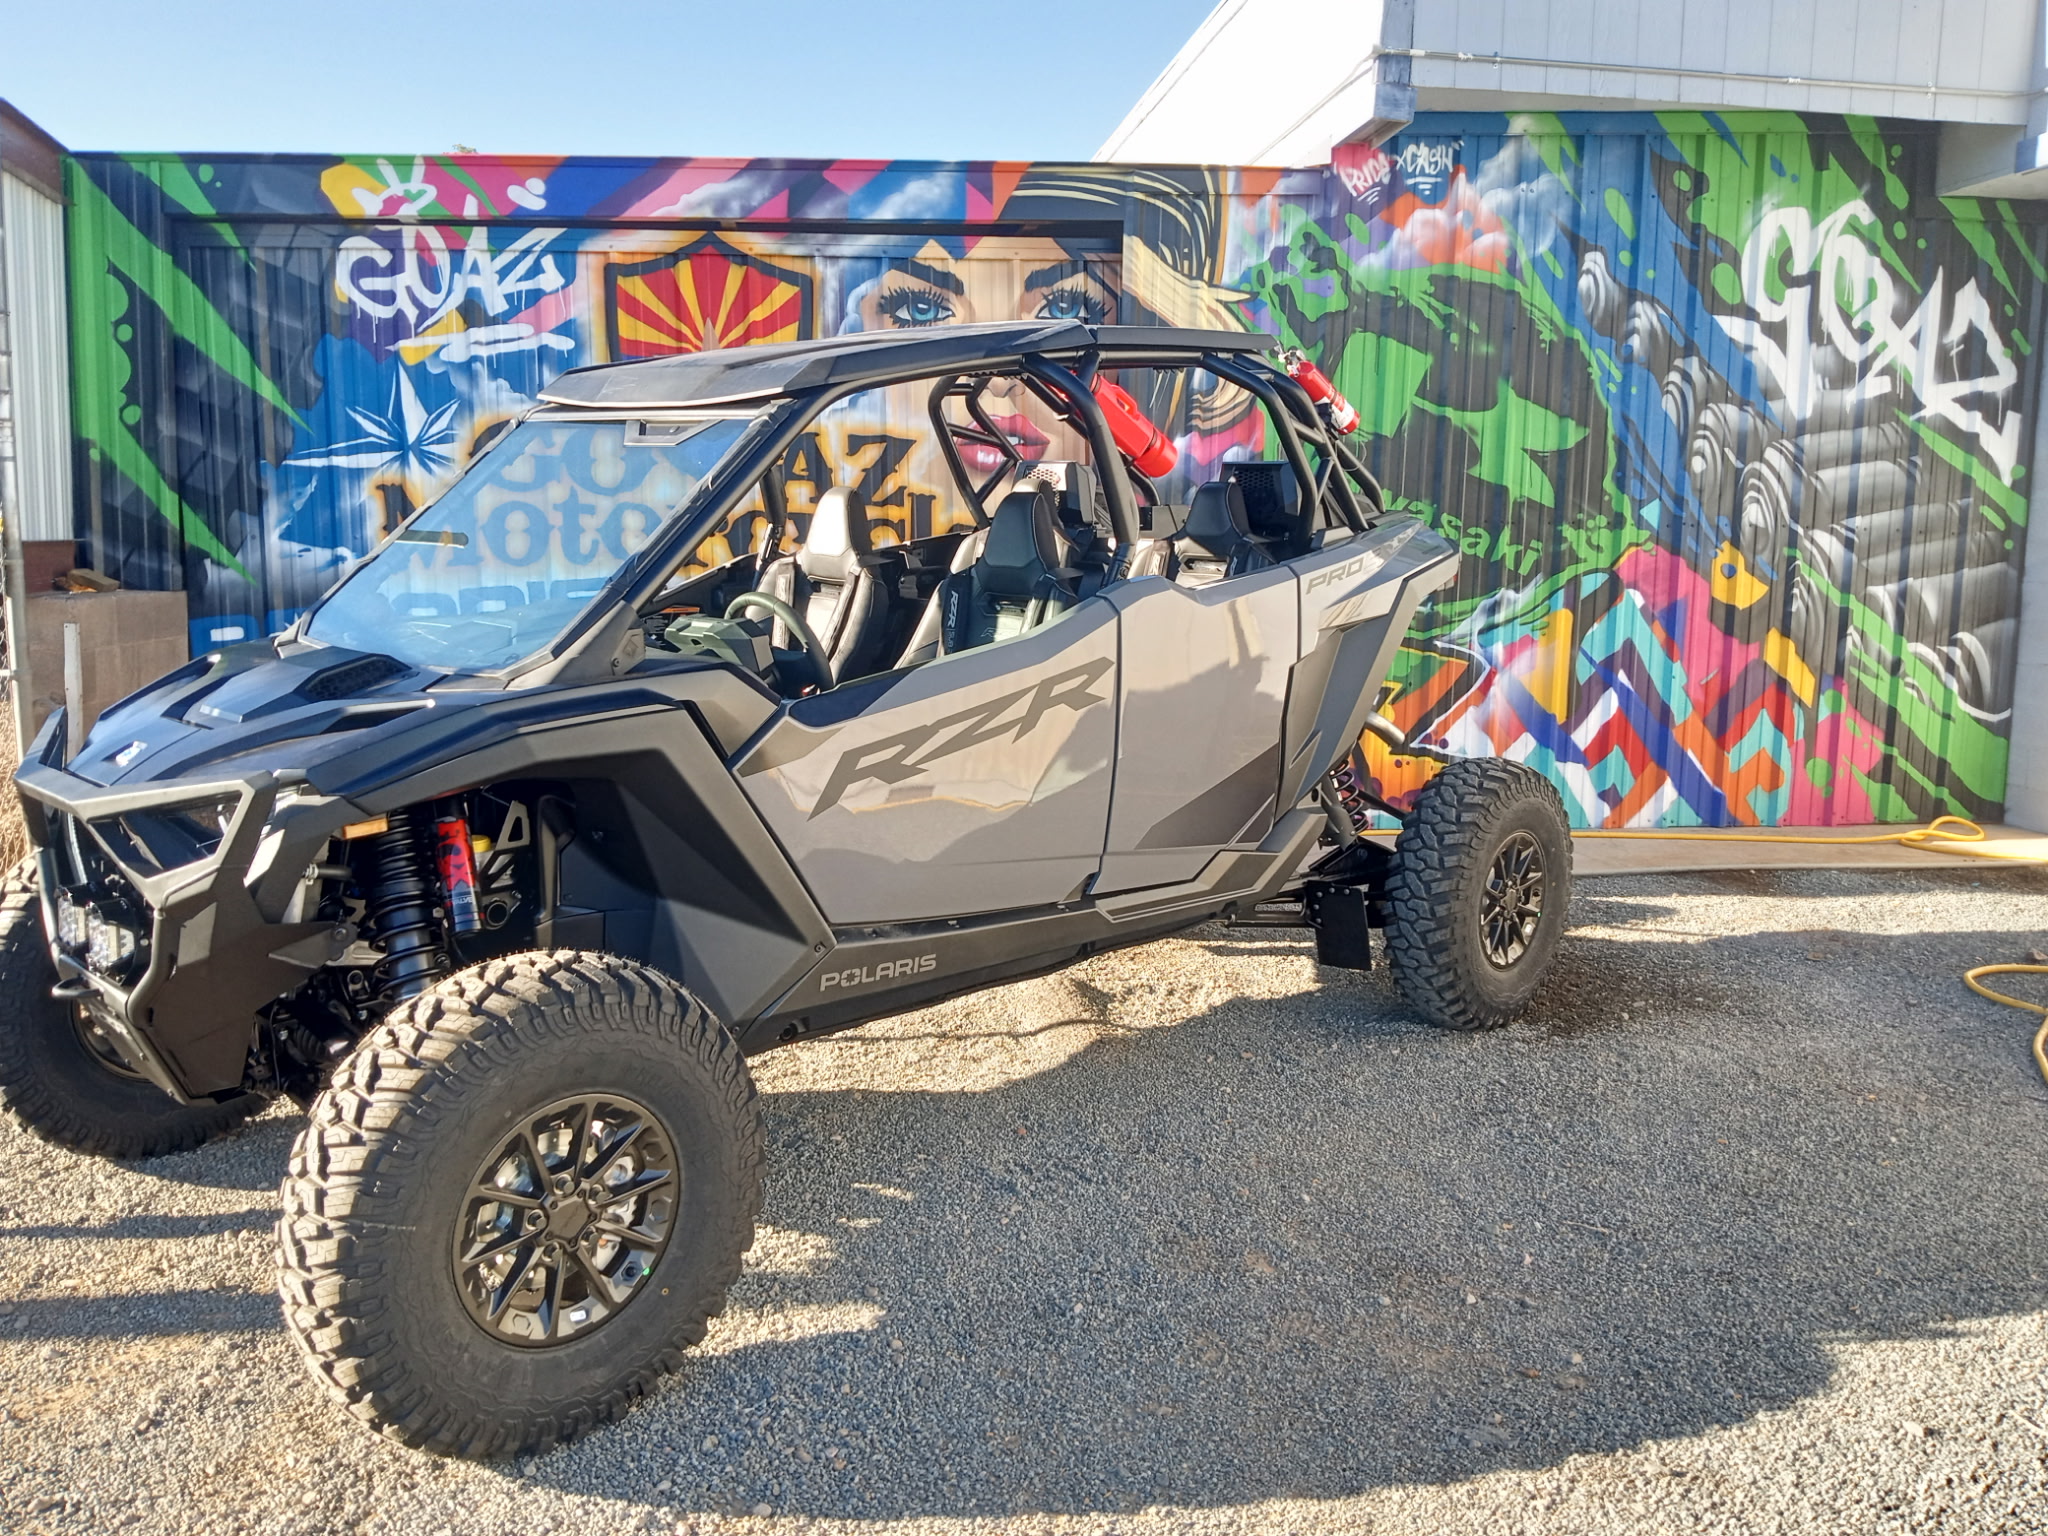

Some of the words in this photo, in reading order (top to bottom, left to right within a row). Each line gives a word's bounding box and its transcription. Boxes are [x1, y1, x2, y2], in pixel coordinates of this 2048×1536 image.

[1305, 557, 1365, 595] PRO
[947, 590, 959, 629] RZR
[806, 656, 1115, 822] RZR
[436, 818, 477, 892] FOX
[819, 953, 937, 992] POLARIS
